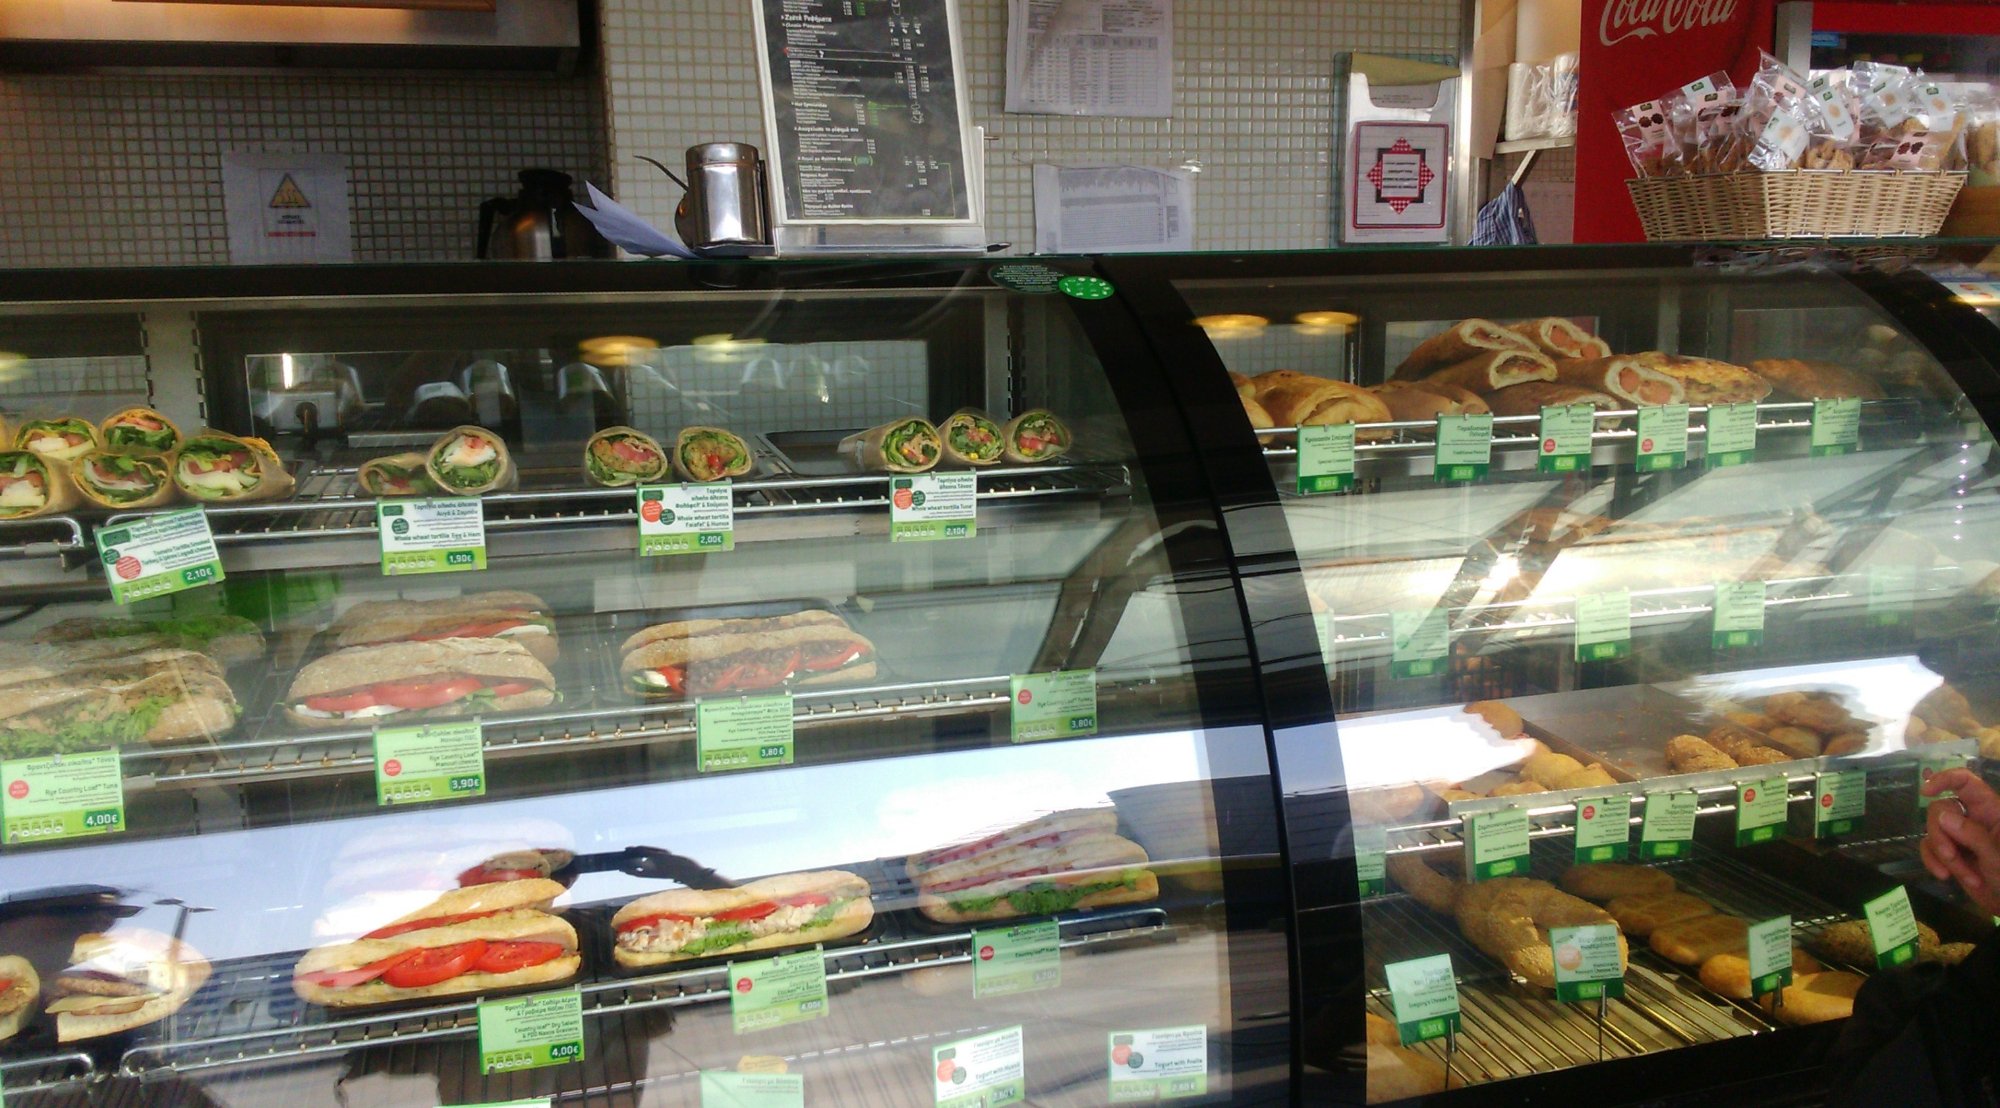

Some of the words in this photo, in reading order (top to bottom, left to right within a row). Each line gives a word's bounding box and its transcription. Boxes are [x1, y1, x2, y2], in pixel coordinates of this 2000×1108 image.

[186, 569, 212, 580] 2,10€
[451, 778, 480, 789] 3,90€
[45, 788, 56, 796] Rye
[58, 786, 83, 794] Country
[86, 814, 118, 826] 4,00€
[551, 1045, 579, 1056] 4,00€
